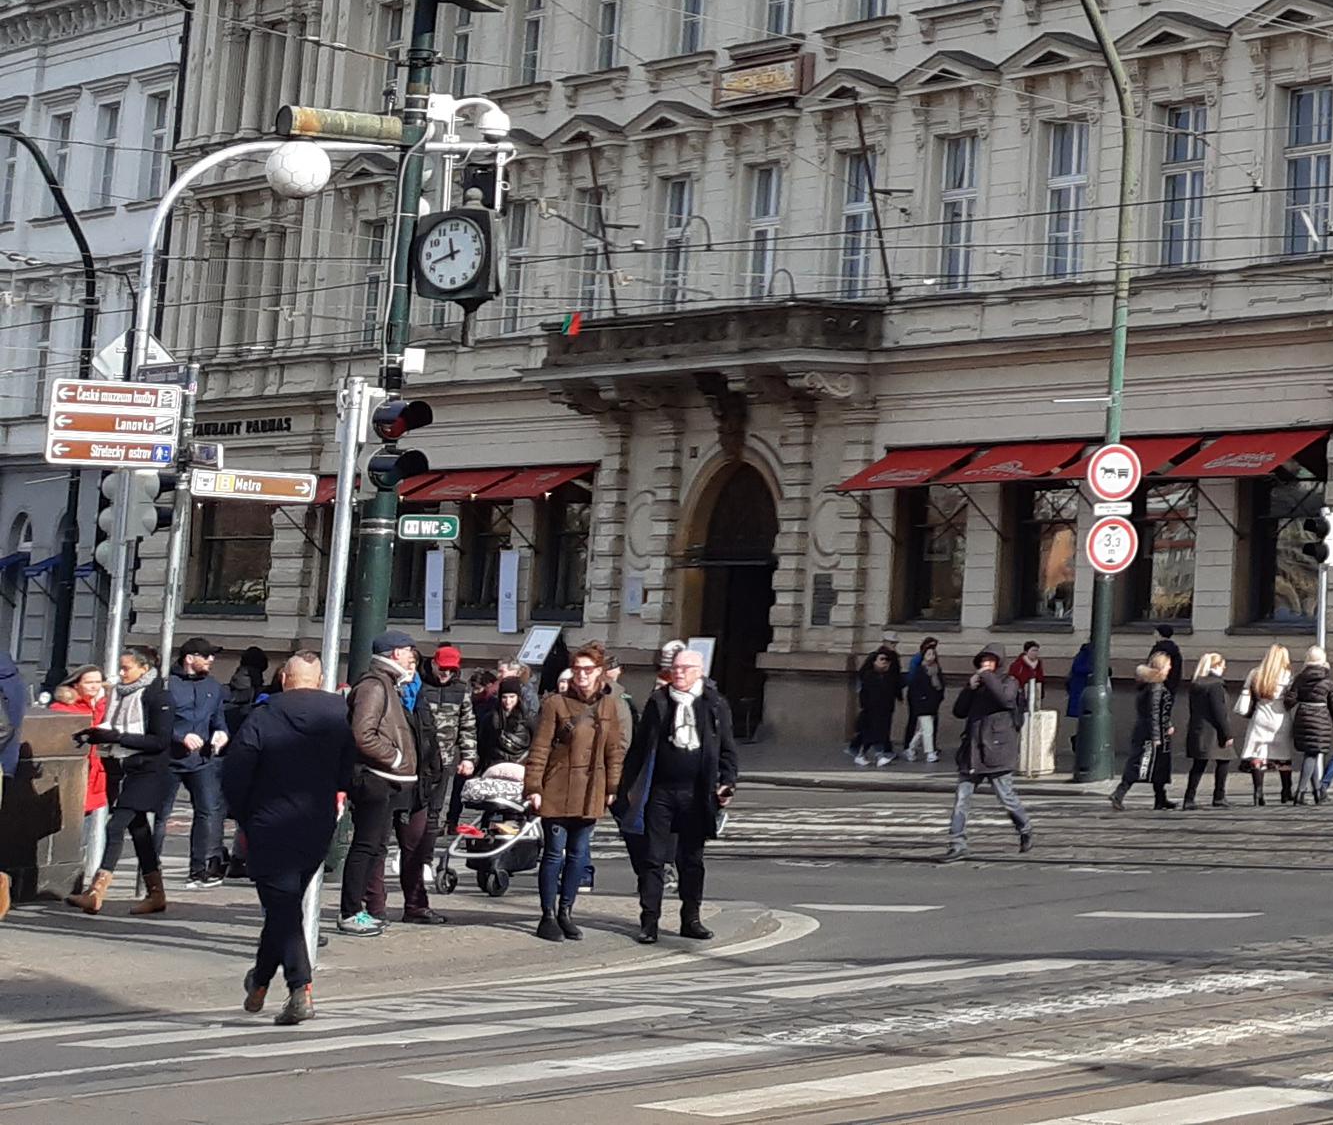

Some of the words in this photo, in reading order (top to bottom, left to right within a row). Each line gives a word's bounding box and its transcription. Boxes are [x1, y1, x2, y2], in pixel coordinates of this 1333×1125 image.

[115, 417, 154, 432] Lanovka
[245, 417, 292, 433] PARNAS
[235, 478, 261, 491] Metro
[421, 520, 439, 535] WC
